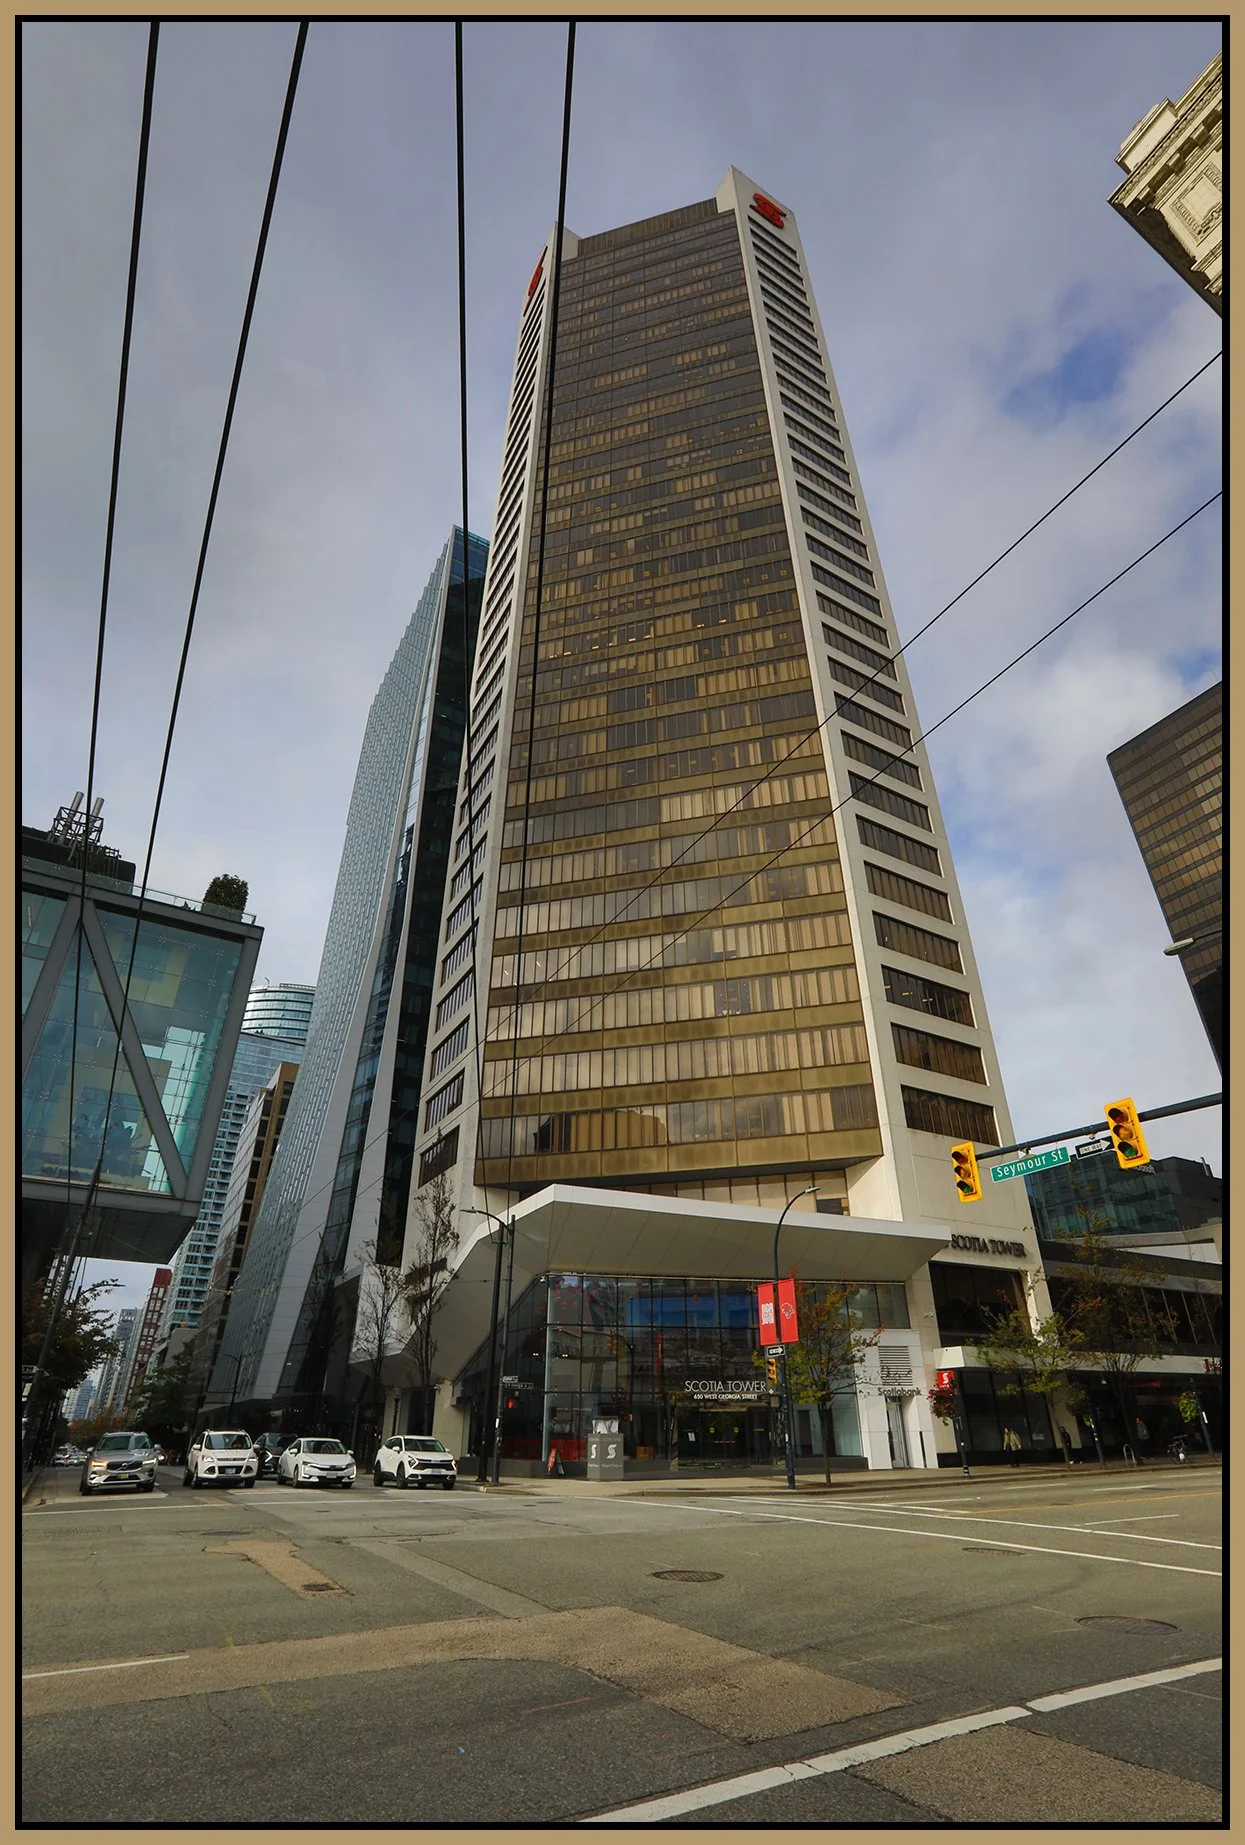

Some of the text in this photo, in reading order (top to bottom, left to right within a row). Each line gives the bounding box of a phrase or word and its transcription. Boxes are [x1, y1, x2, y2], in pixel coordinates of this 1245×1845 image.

[997, 1149, 1063, 1177] Seymour St
[951, 1233, 1027, 1258] SCOTIA TOWER
[684, 1380, 767, 1392] SCOTIA TOWER
[877, 1387, 922, 1396] Scotiabank
